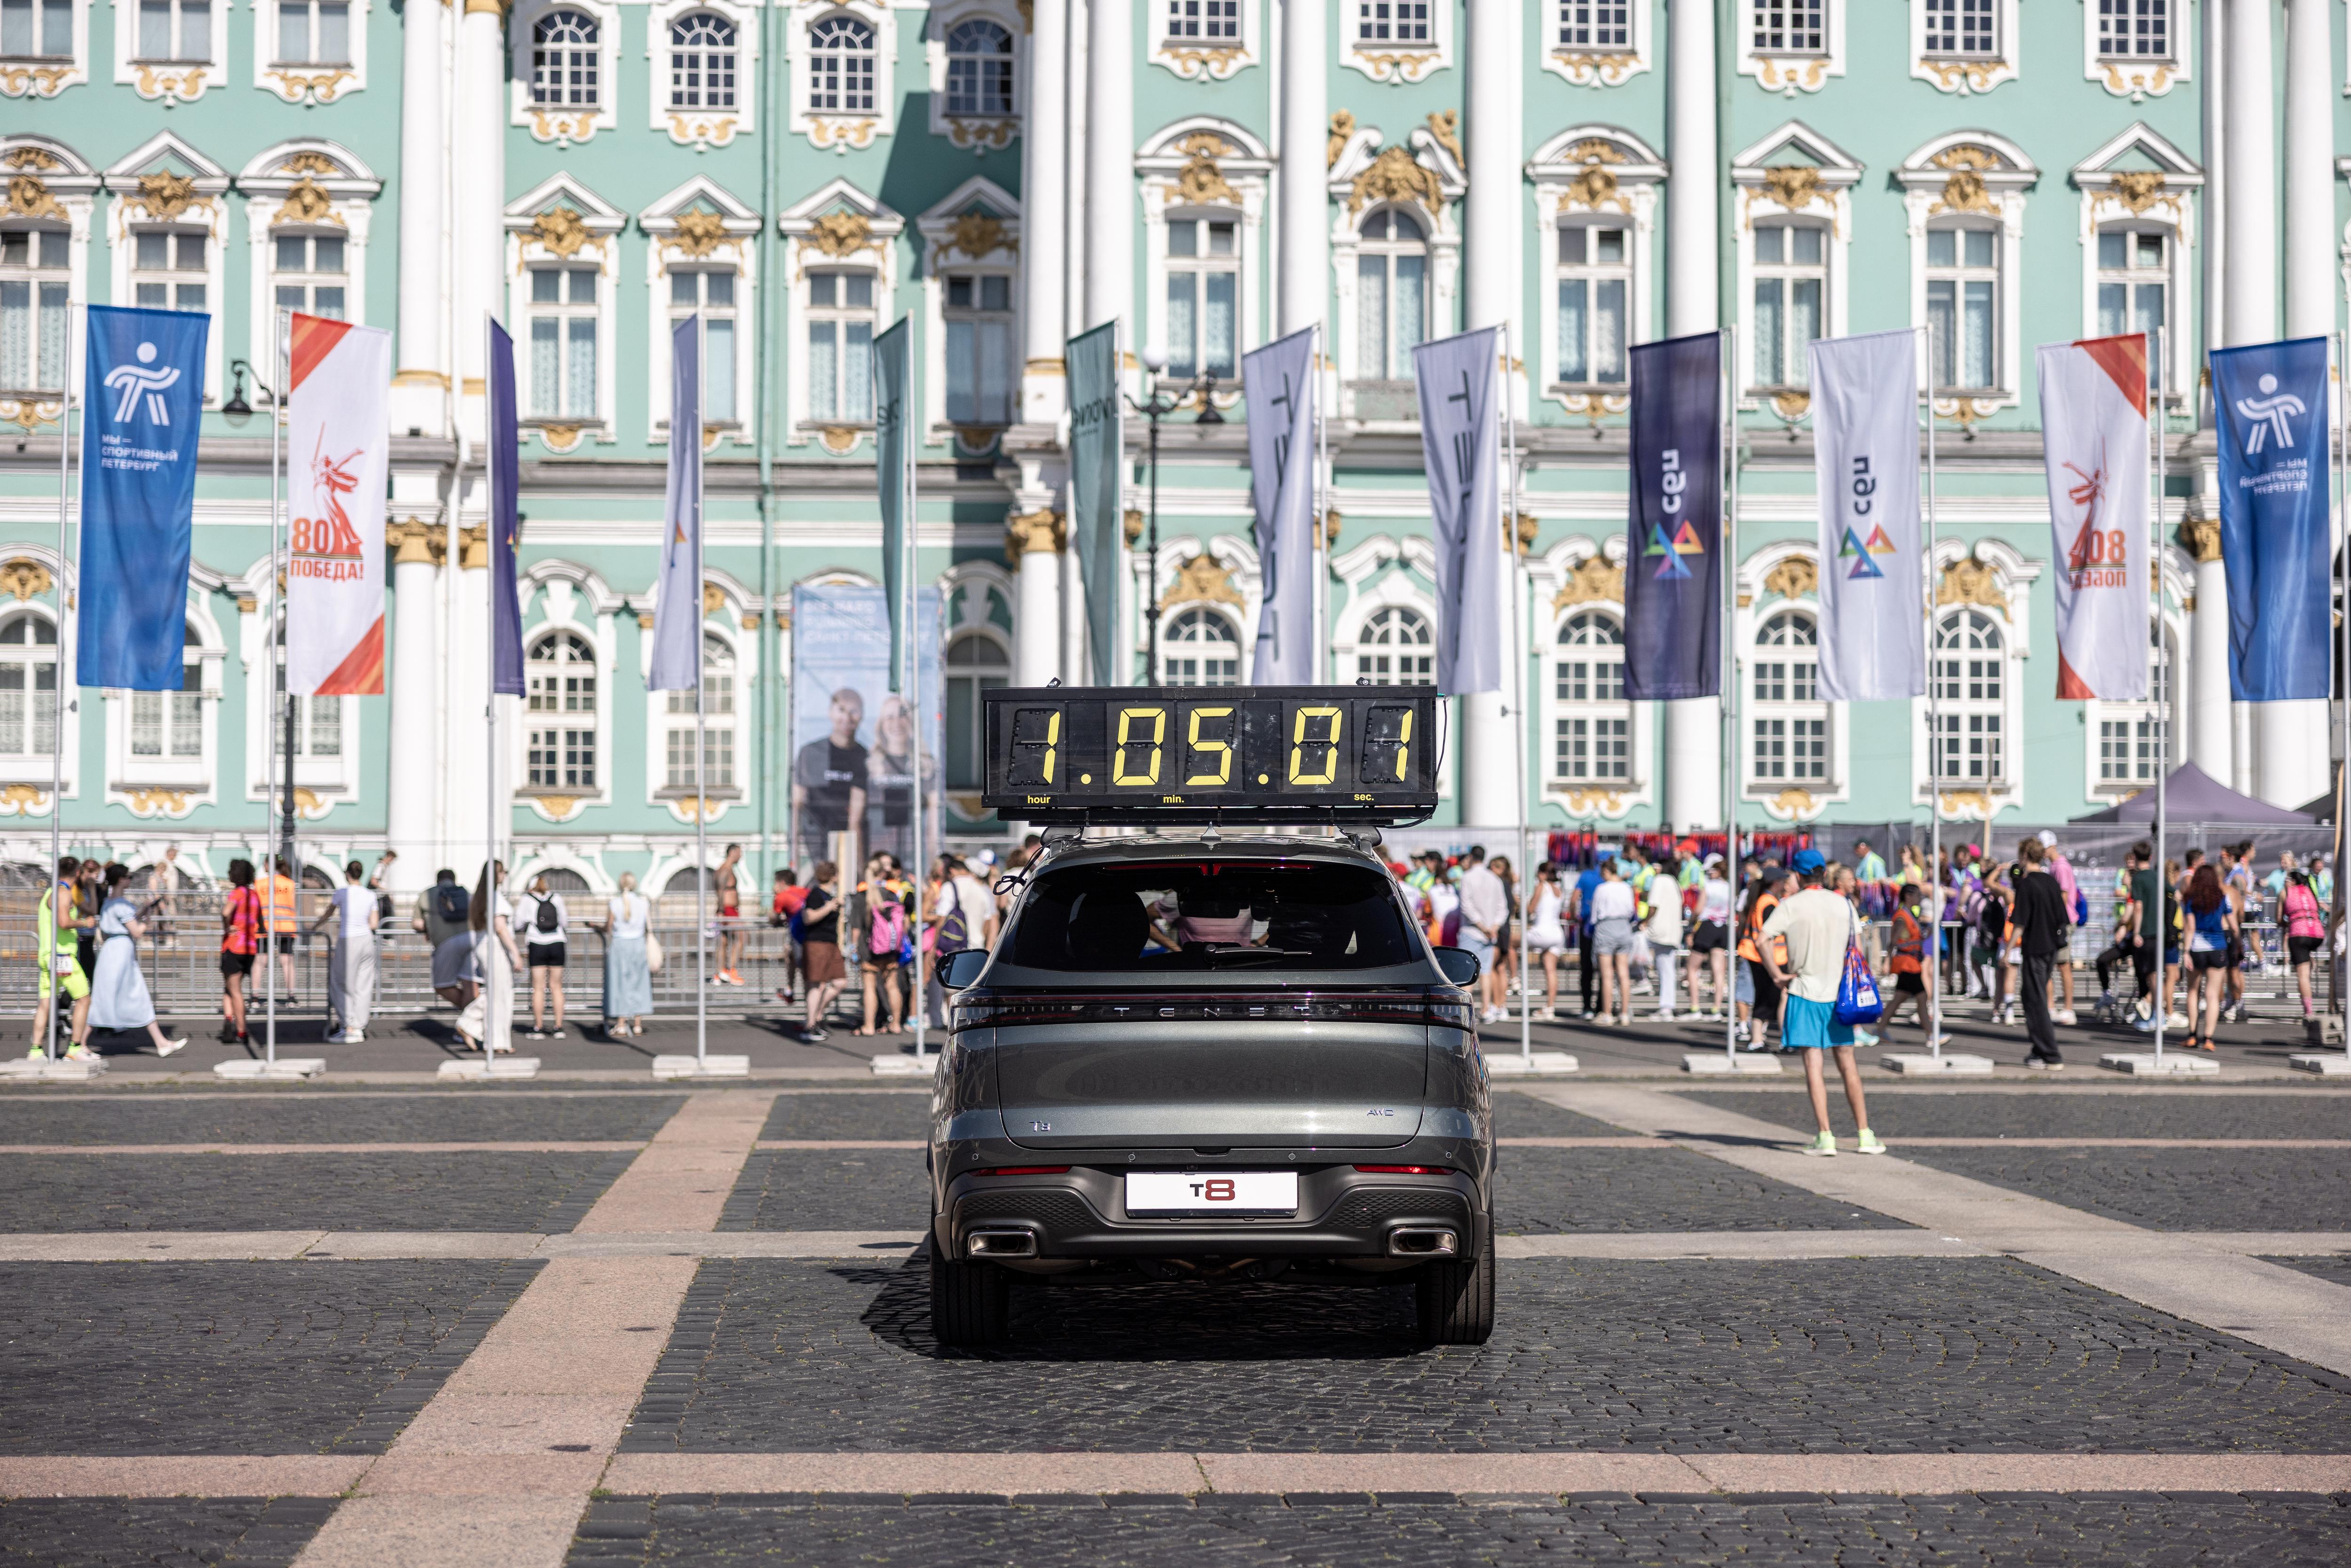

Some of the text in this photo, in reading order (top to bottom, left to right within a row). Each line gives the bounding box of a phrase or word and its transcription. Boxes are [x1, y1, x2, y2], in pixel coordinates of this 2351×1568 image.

[102, 433, 120, 445] МЫ
[102, 446, 178, 462] СПОРТИВНЫЙ
[101, 457, 160, 472] ПЕТЕРБУРГ
[293, 518, 329, 553] 80
[290, 559, 363, 581] ПОБЕДА!
[1027, 795, 1051, 804] hour
[1163, 795, 1184, 803] min.
[1114, 1006, 1310, 1016] TENET
[1029, 1121, 1050, 1132] T8
[1190, 1179, 1235, 1201] T8
